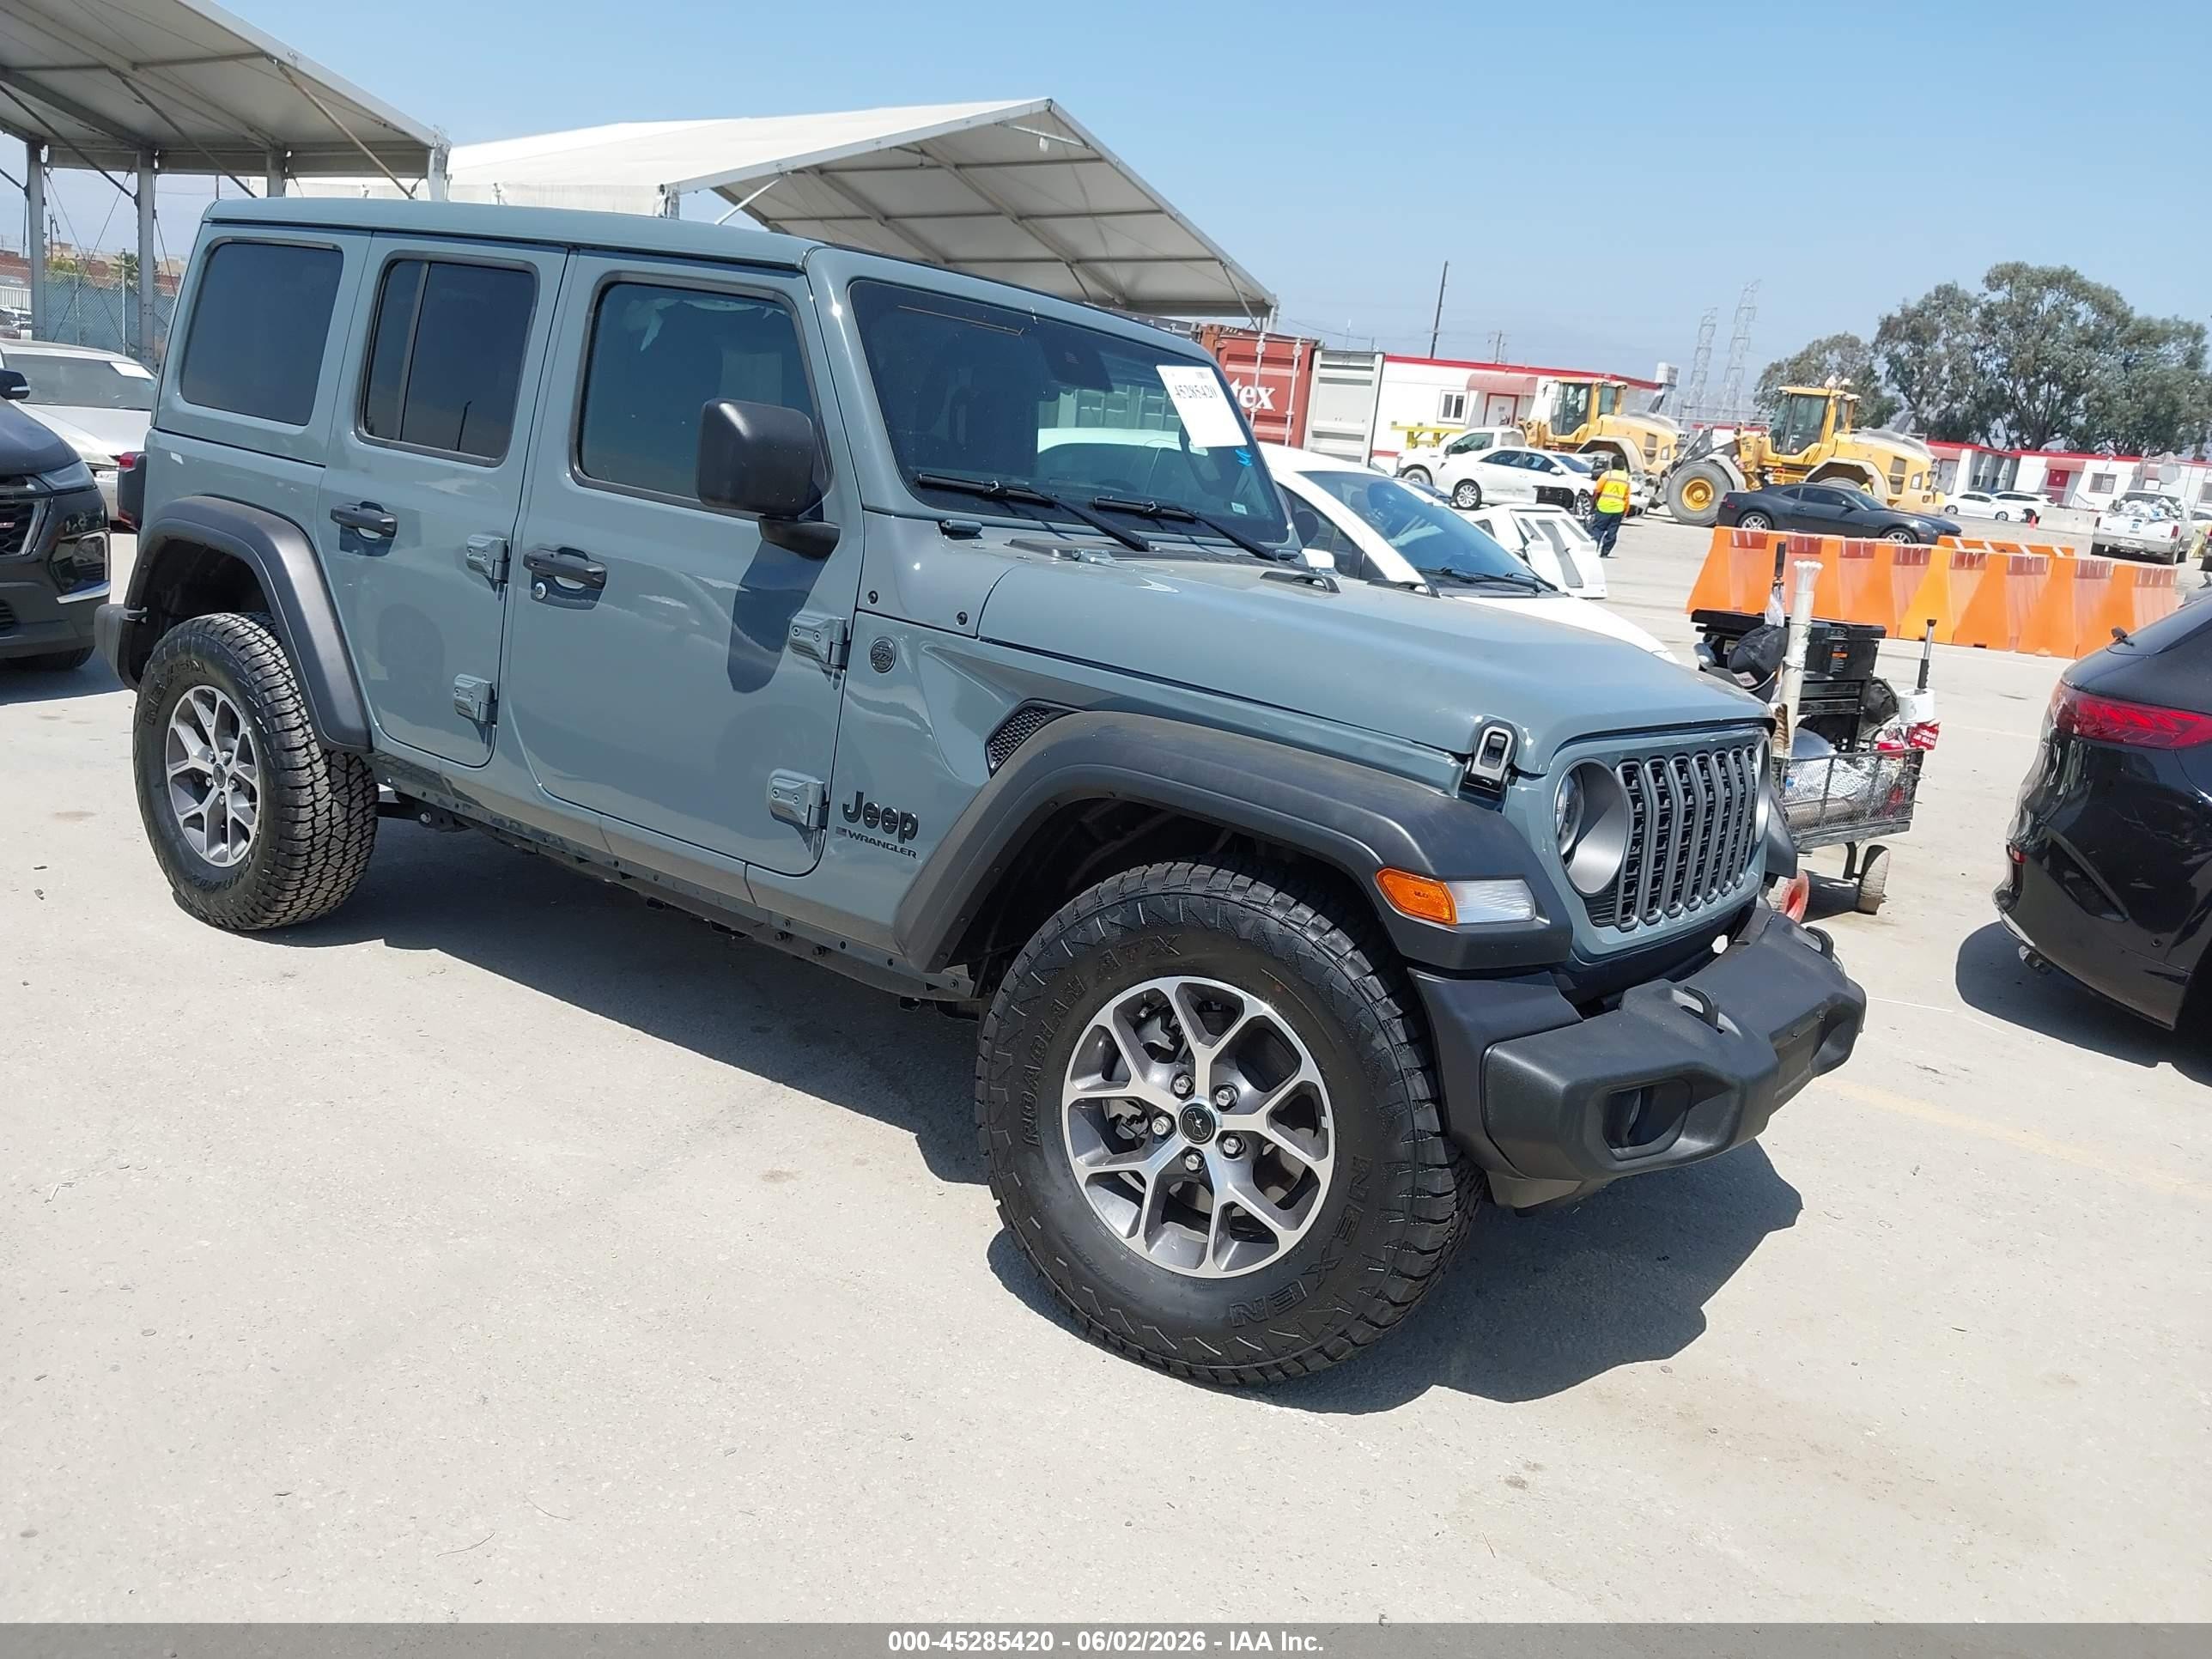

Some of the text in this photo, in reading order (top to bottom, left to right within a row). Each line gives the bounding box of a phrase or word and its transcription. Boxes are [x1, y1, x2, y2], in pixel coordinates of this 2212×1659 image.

[1230, 378, 1274, 410] tex
[842, 790, 919, 844] Jeep
[848, 830, 917, 860] WRANGLER
[1229, 1156, 1374, 1328] NEXEN
